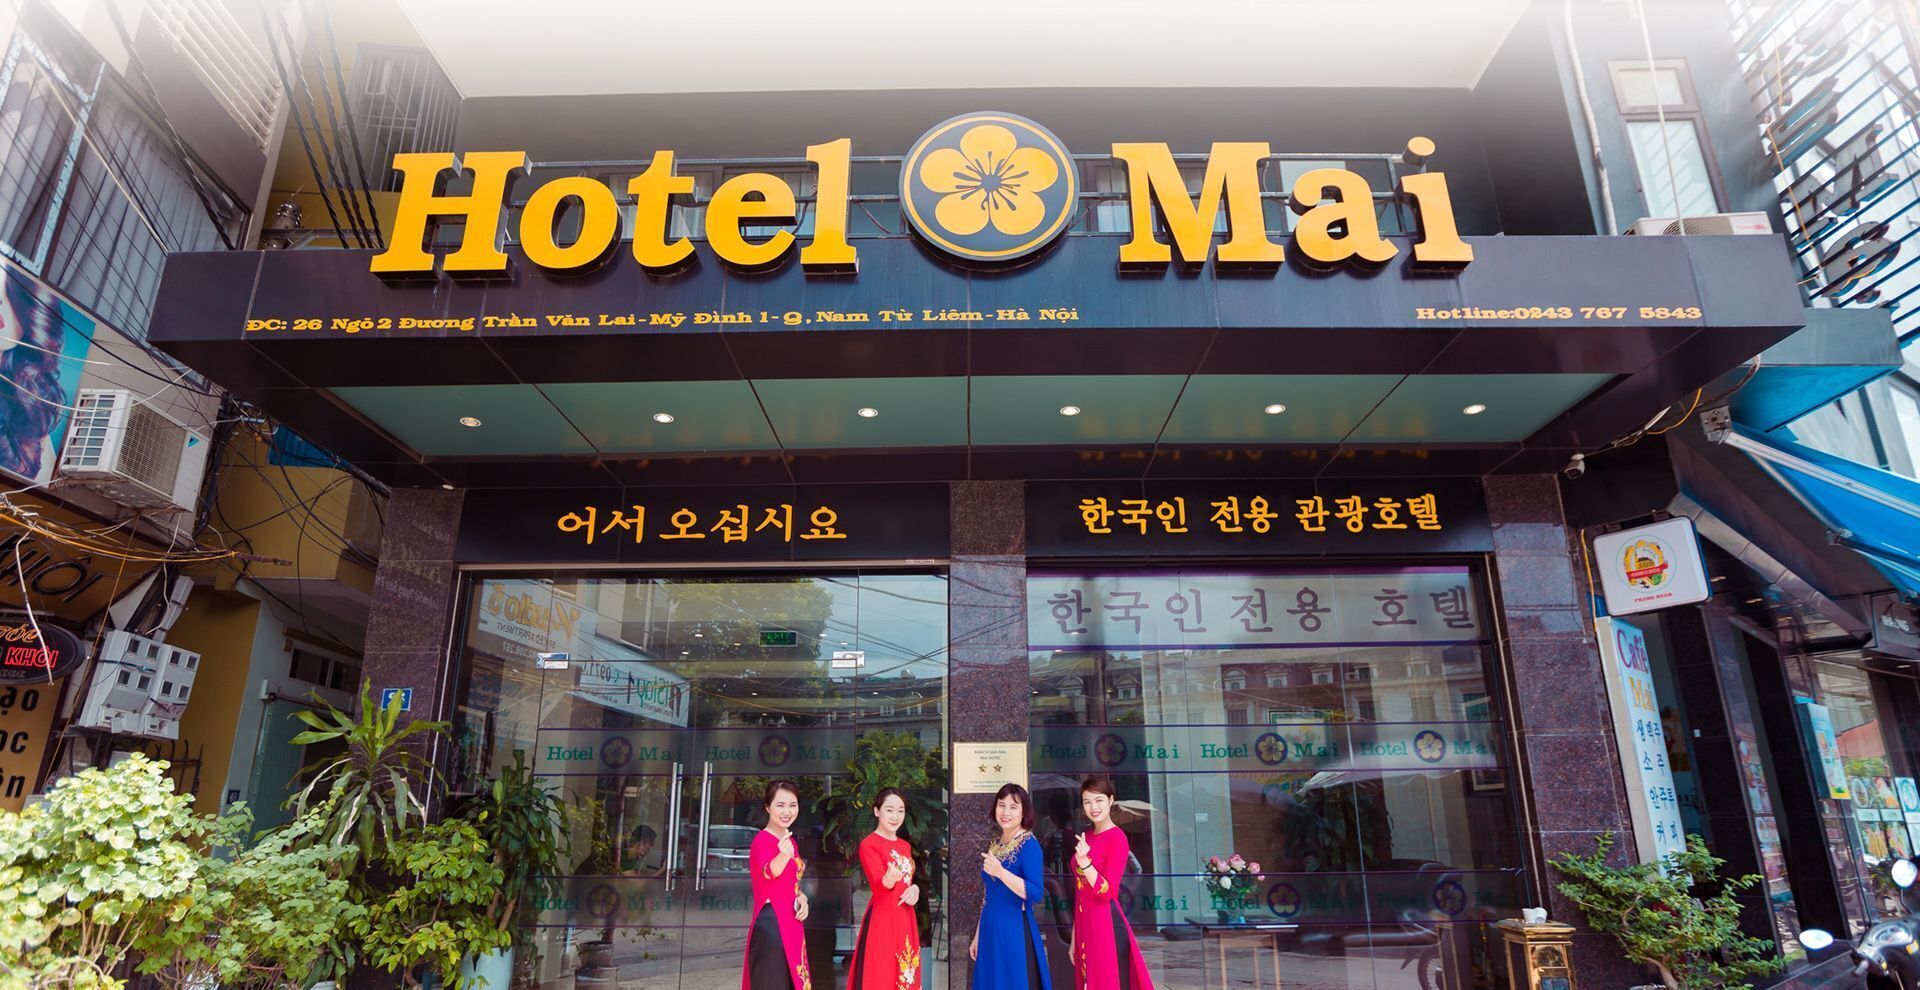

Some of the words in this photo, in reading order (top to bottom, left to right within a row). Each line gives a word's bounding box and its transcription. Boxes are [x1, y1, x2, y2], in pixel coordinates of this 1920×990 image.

[370, 138, 858, 276] Hotel
[1111, 136, 1474, 265] Mai
[246, 319, 287, 331] ĐC:
[292, 319, 323, 330] 26
[376, 318, 392, 329] 2
[694, 311, 752, 324] Đình
[816, 311, 870, 323] Nam
[1039, 307, 1079, 323] Nội
[1580, 307, 1627, 320] 767
[1639, 307, 1702, 320] 5843
[1078, 496, 1188, 535] 한국인
[1210, 496, 1278, 533] 전용
[1295, 493, 1442, 533] 관광호텔
[557, 505, 645, 544] 어서
[659, 504, 847, 543] 오십시요
[1372, 584, 1474, 630] 호텔
[547, 746, 593, 761] Hotel
[639, 746, 682, 761] Mai
[705, 746, 751, 761] Hotel
[1039, 743, 1088, 759] Hotel
[1134, 744, 1179, 759] Mai
[1200, 743, 1248, 759] Hotel
[1293, 743, 1338, 758] Mai
[1359, 741, 1408, 757] Hotel
[1141, 895, 1189, 911] Mai
